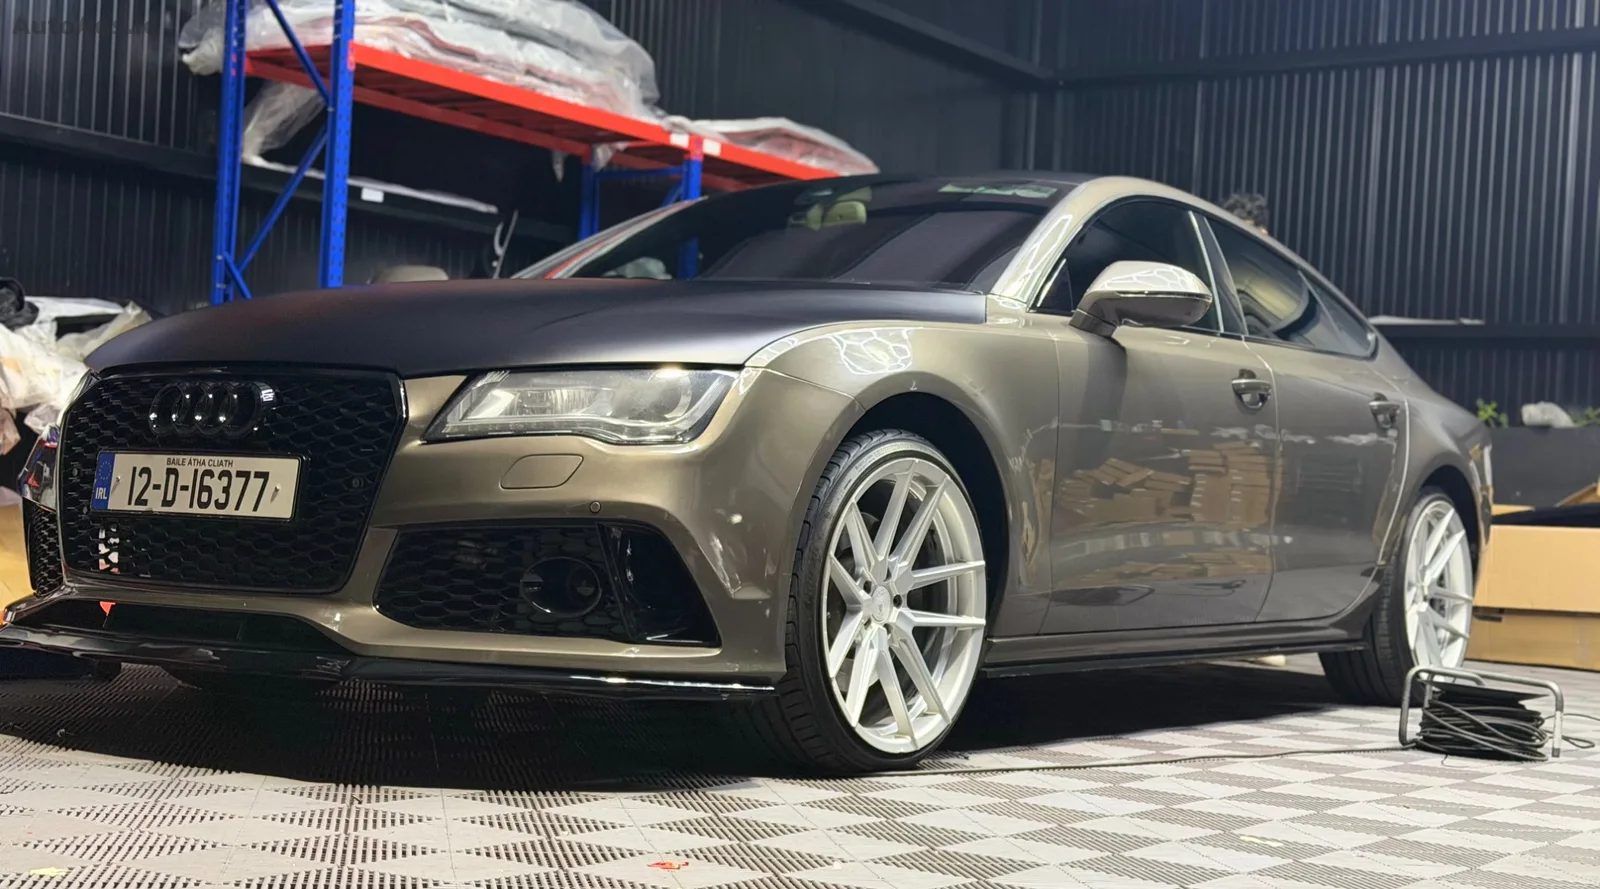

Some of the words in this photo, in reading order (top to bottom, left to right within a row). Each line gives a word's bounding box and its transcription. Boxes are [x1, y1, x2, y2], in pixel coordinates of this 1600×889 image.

[166, 457, 186, 466] BAILE
[187, 457, 206, 467] ÁTHA
[207, 458, 234, 468] CLIATH
[95, 487, 108, 500] IRL
[127, 466, 270, 512] 12-D-16377
